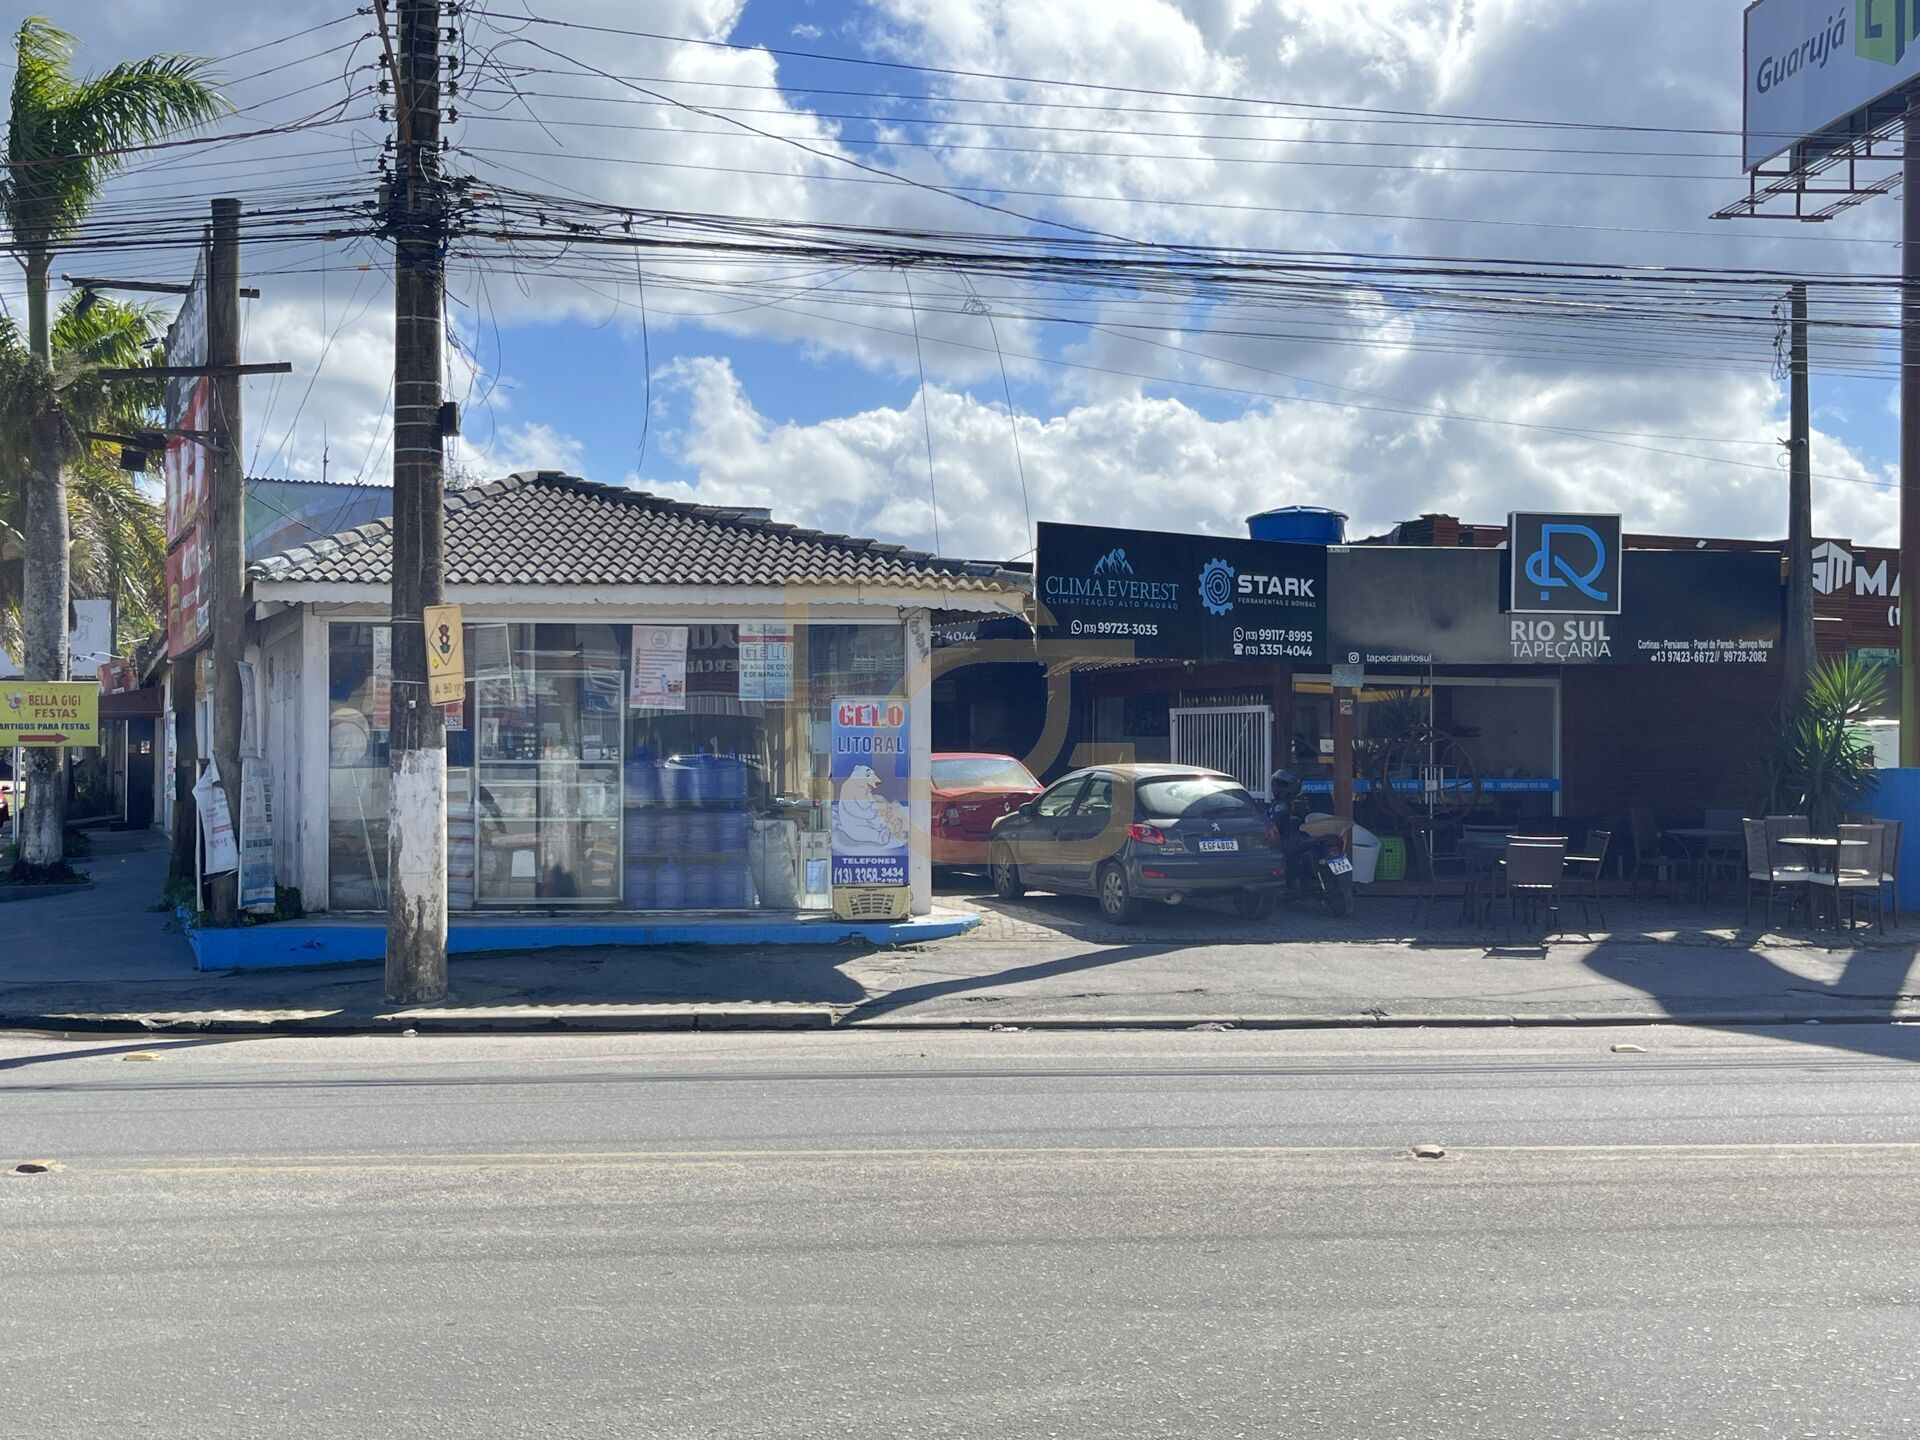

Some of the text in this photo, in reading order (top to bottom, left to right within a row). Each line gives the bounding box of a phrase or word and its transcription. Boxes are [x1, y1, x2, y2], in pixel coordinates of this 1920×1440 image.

[1756, 7, 1847, 93] Guarujá
[1045, 576, 1179, 601] CLIMA EVEREST
[1237, 574, 1315, 598] STARK
[1046, 597, 1114, 607] CLIMATIZAÇÃO
[1238, 597, 1284, 606] FERRAMENTAS
[1291, 600, 1316, 608] BOMBAS
[1083, 622, 1159, 635] (13) 99723-3035
[1511, 620, 1611, 641] RIO SUL
[1245, 629, 1313, 642] (13) 99117-8995
[1245, 644, 1313, 657] (13) 3351-4044
[1637, 639, 1660, 649] Cortinas
[1664, 639, 1690, 649] Persianas
[1693, 639, 1709, 650] Papel
[1758, 639, 1773, 649] Naval
[742, 644, 793, 661] GELO
[1510, 642, 1611, 661] TAPEÇARIA
[1723, 651, 1767, 662] 99728-2082
[28, 694, 81, 706] BELLA GIGI
[35, 708, 78, 718] FESTAS
[839, 703, 905, 727] GELO
[38, 723, 59, 731] PARA
[61, 723, 90, 731] FESTAS
[837, 736, 906, 753] LITORAL
[842, 857, 897, 865] TELEFONES
[834, 867, 853, 884] (13)
